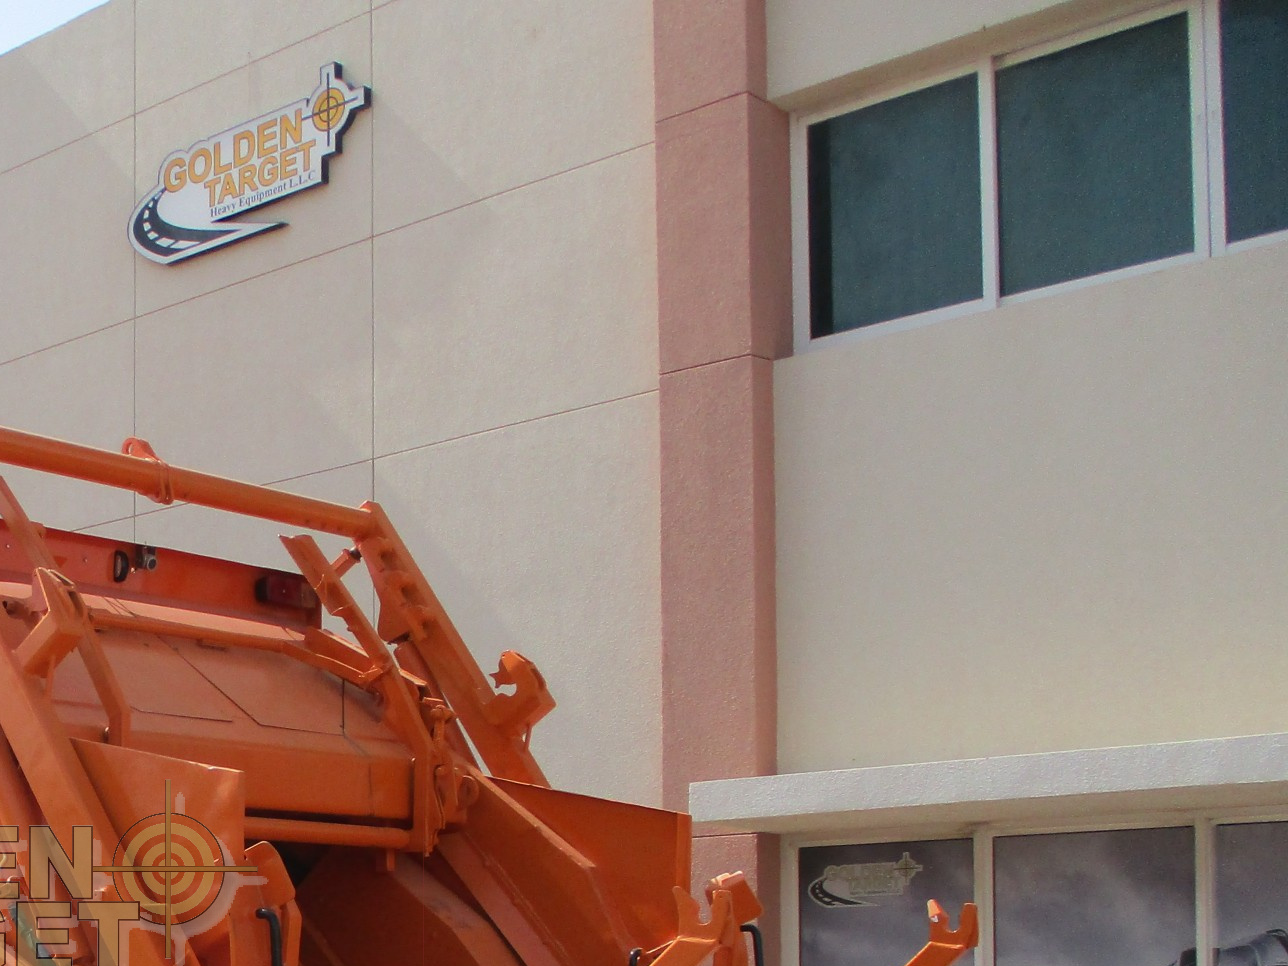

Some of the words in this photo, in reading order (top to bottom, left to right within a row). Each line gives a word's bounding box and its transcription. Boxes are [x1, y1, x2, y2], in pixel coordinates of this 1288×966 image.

[165, 109, 302, 192] GOLDEN
[204, 140, 316, 207] TARGET
[210, 203, 236, 218] Heavy
[239, 183, 287, 207] Equipment
